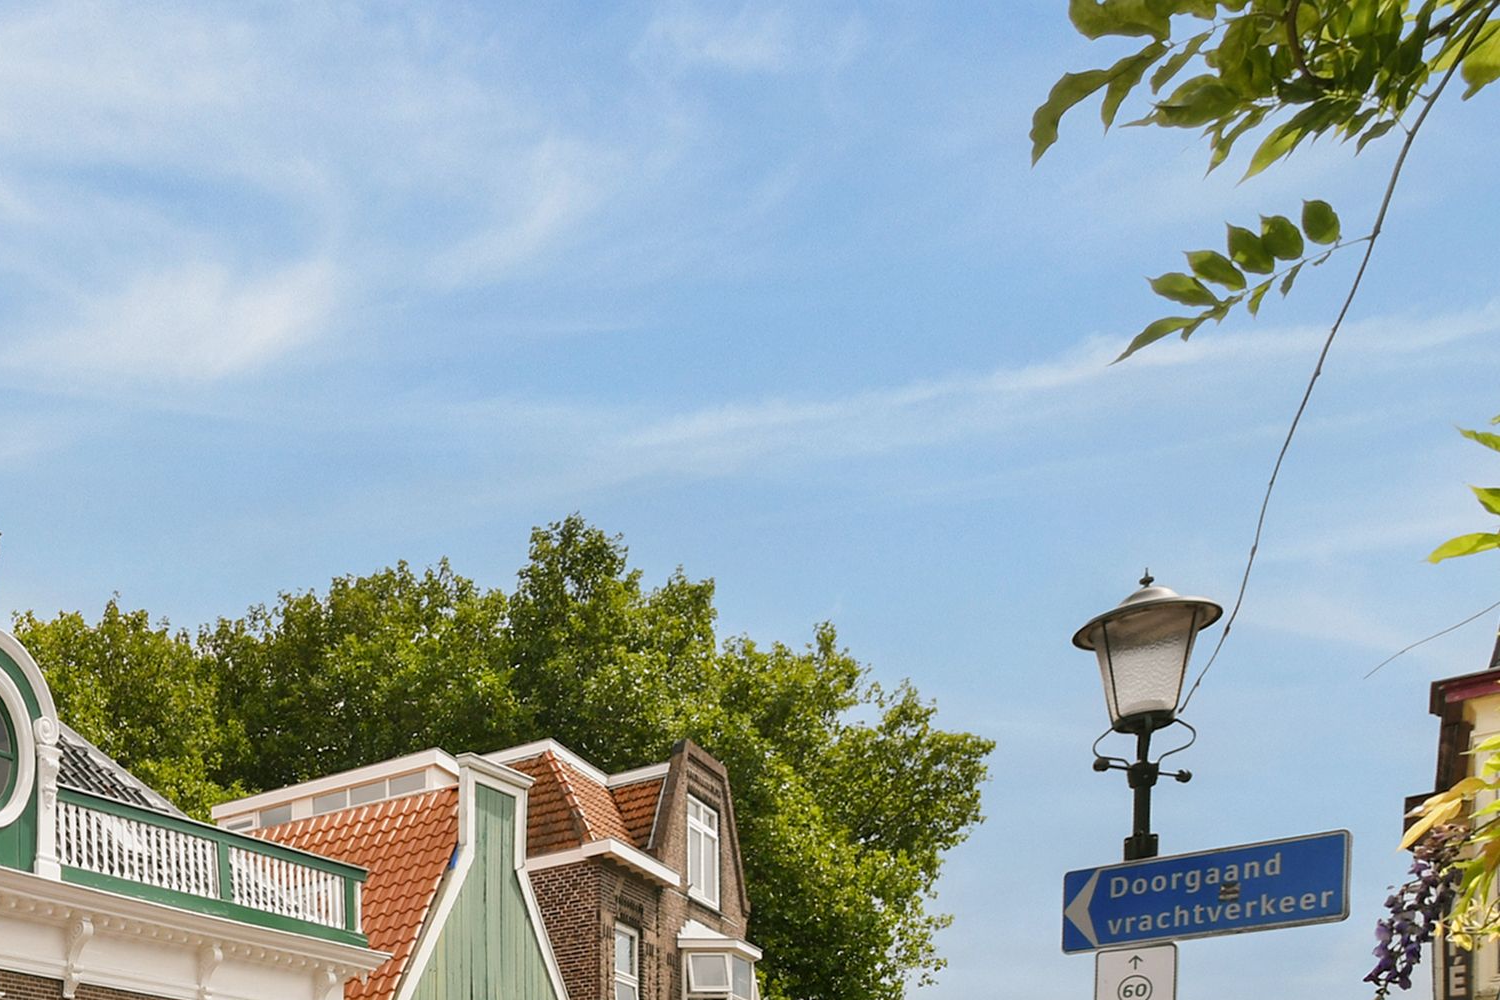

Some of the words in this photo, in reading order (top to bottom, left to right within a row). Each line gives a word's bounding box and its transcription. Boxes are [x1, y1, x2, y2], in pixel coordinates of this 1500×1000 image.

[1110, 852, 1281, 898] Doorgaand
[1108, 890, 1334, 935] vrachtverkeer
[1123, 983, 1147, 998] 60
